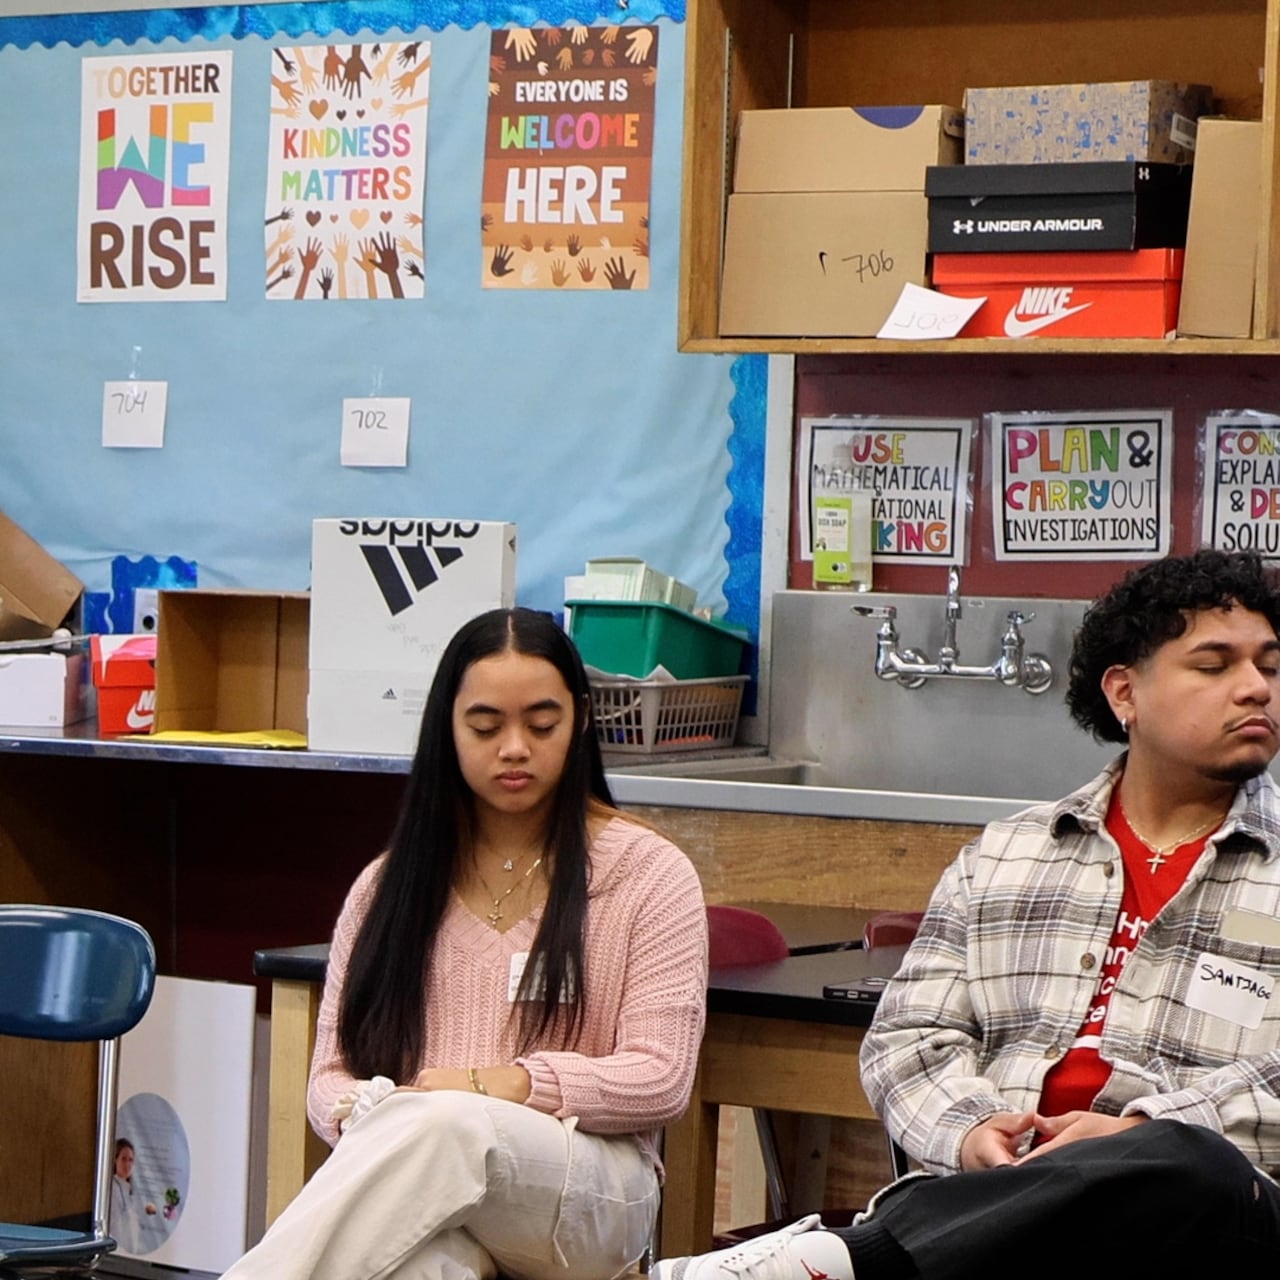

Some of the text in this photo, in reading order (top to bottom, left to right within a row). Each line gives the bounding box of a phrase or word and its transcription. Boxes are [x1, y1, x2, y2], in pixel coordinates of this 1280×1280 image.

[92, 63, 220, 99] TOGETHER
[515, 78, 629, 102] EVERYONE IS
[283, 123, 411, 159] KINDNESS
[500, 112, 640, 149] WELCOME
[96, 102, 214, 211] WE
[281, 165, 412, 202] MATTERS
[504, 165, 627, 225] HERE
[978, 217, 1104, 234] UNDER ARMOUR
[90, 217, 216, 290] RISE
[842, 250, 894, 283] 706
[1017, 287, 1074, 315] NIKE
[111, 391, 148, 414] 704
[351, 409, 389, 430] 702
[853, 433, 907, 465] USE
[1008, 427, 1154, 474] PLAN &
[1220, 430, 1280, 455] CON
[814, 464, 952, 491] MATHEMATICAL
[872, 499, 945, 520] TATIONAL
[1006, 479, 1156, 512] CARRY OUT
[1230, 489, 1245, 512] &
[1006, 518, 1157, 541] INVESTIGATIONS
